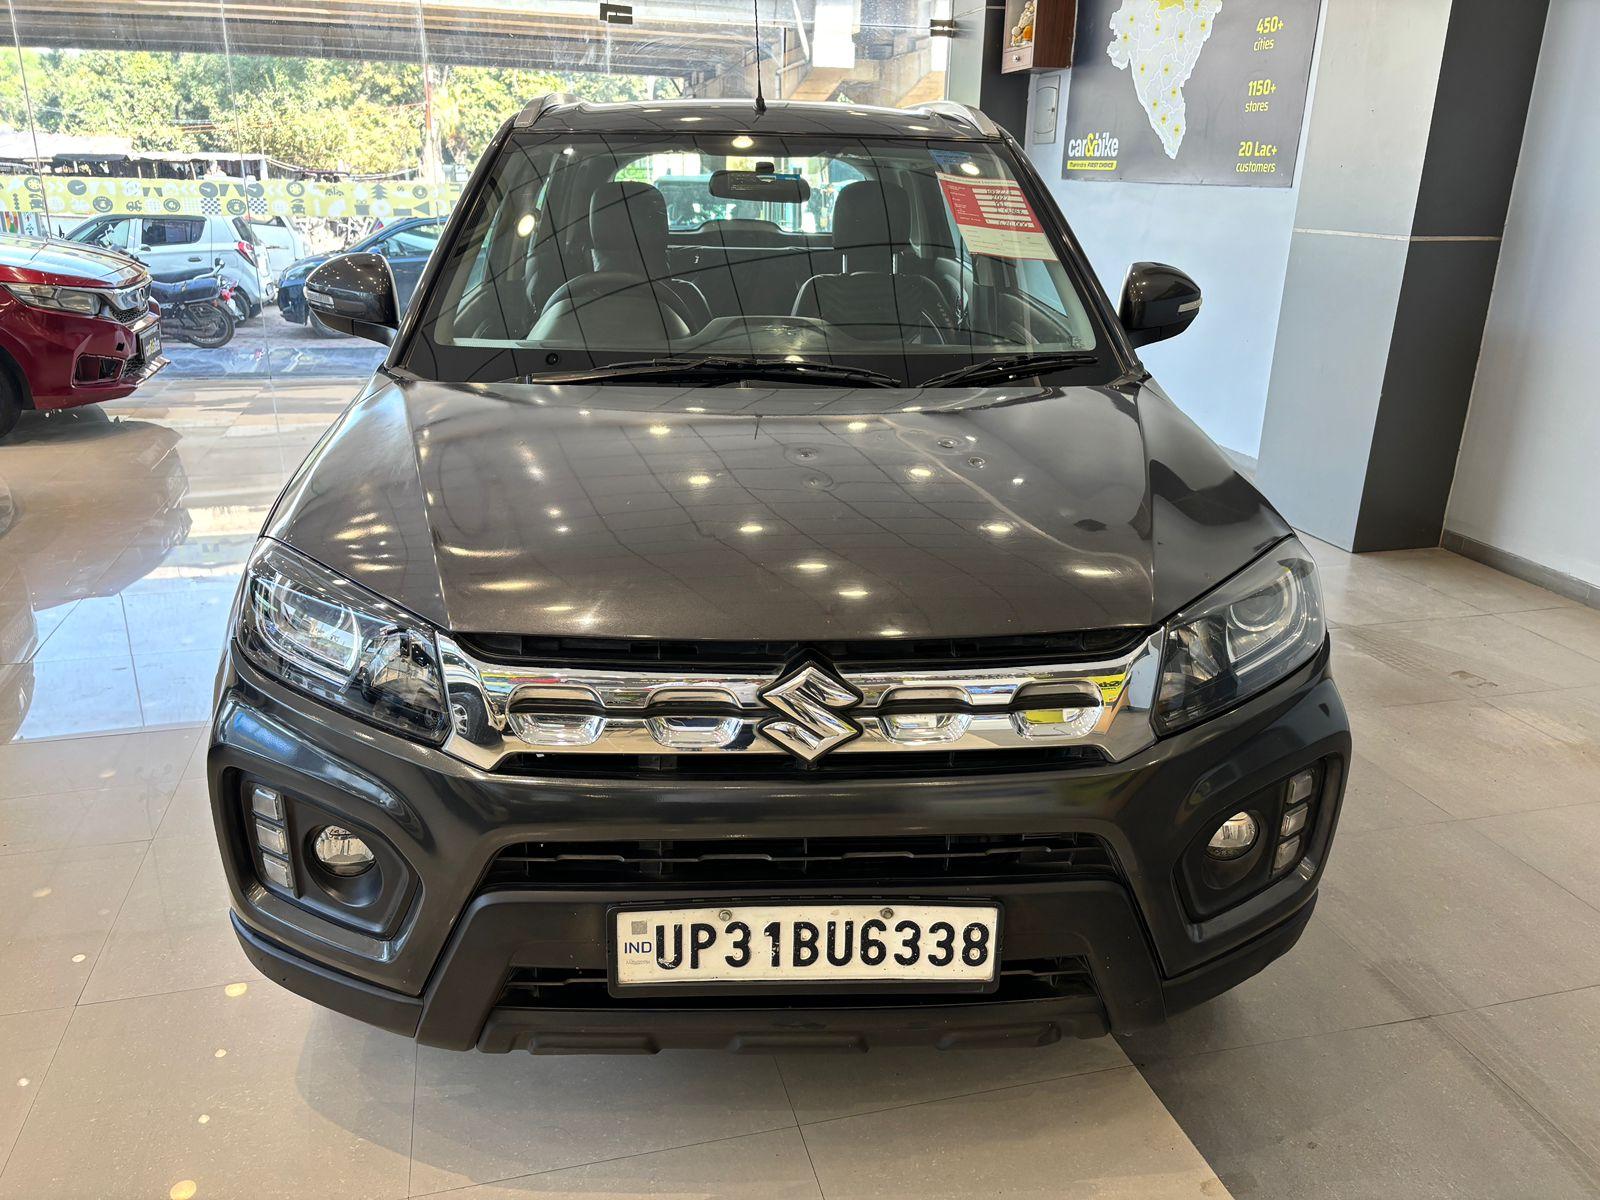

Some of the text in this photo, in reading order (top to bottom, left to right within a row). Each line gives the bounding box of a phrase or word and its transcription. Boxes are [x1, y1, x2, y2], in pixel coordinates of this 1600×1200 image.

[1256, 16, 1284, 34] 450+
[1253, 36, 1275, 51] cities
[1248, 79, 1277, 96] 1150+
[1244, 101, 1269, 113] stores
[1068, 132, 1119, 157] car&bike
[1238, 141, 1278, 157] 20 Lac+
[1235, 161, 1276, 173] customers
[624, 941, 653, 954] IND
[655, 919, 990, 971] UP31BU6338
